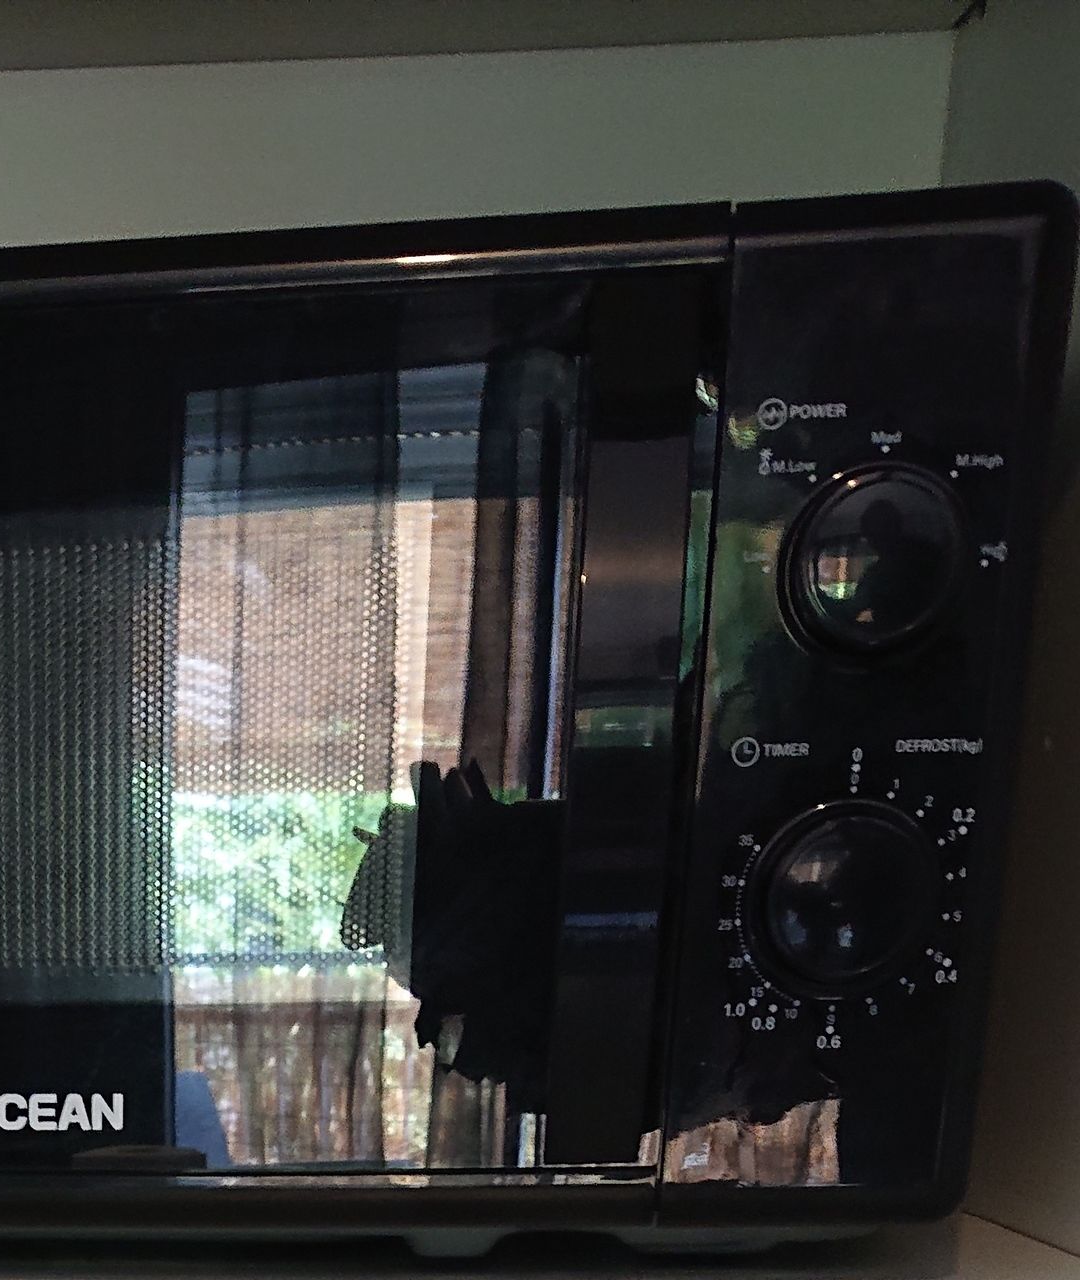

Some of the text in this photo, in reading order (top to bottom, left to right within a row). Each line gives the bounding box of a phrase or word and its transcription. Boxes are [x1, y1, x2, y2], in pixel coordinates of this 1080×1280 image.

[788, 402, 848, 420] POWER
[763, 742, 810, 758] TIMER
[852, 746, 863, 763] 0
[893, 778, 900, 790] 1
[924, 794, 934, 808] 2
[951, 807, 976, 823] 0.2
[958, 866, 967, 879] 4
[717, 918, 734, 931] 25
[727, 956, 744, 969] 20
[934, 968, 958, 985] 0.4
[750, 986, 764, 998] 15
[723, 1002, 746, 1017] 1.0
[784, 1007, 798, 1021] 10
[751, 1015, 776, 1031] 0.8
[816, 1034, 842, 1050] 0.6
